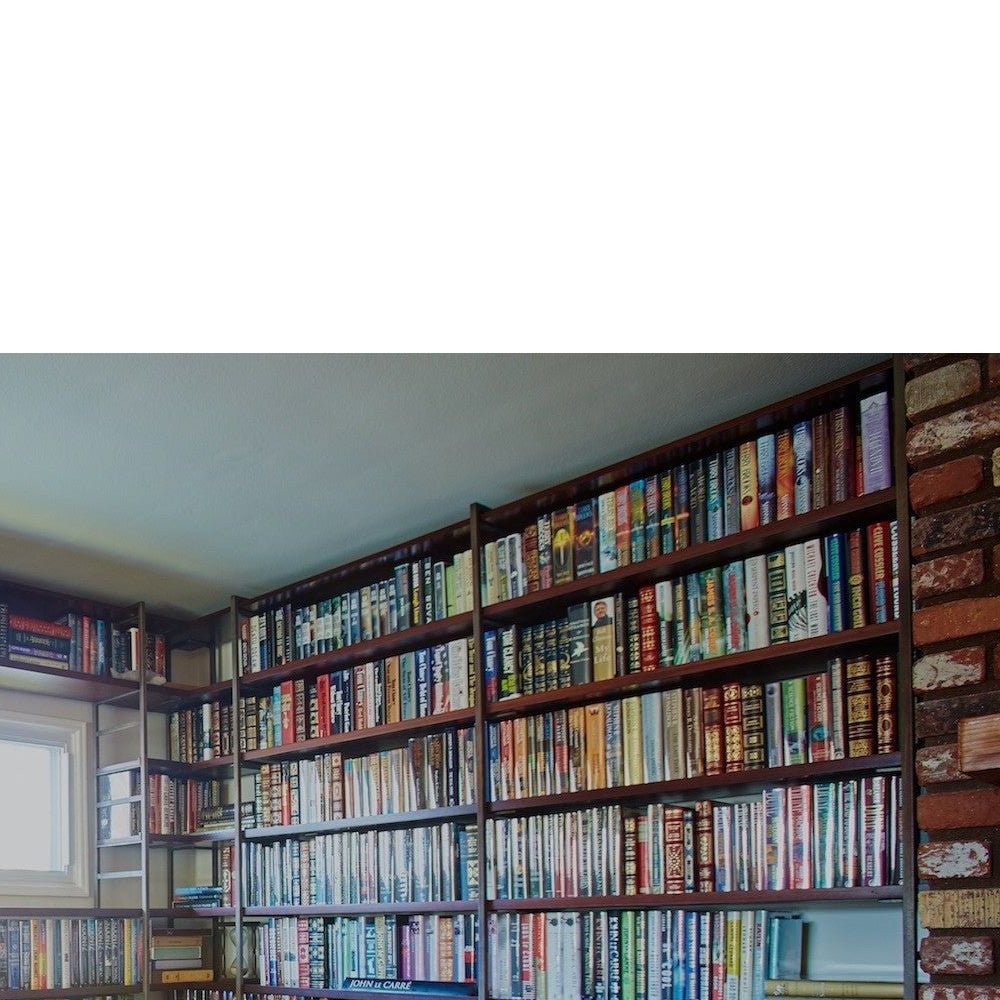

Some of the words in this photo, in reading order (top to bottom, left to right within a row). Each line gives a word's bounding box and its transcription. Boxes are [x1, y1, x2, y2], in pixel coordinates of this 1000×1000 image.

[873, 526, 883, 547] CLIVE
[874, 547, 885, 580] CUSSLER
[349, 979, 371, 988] JOHN
